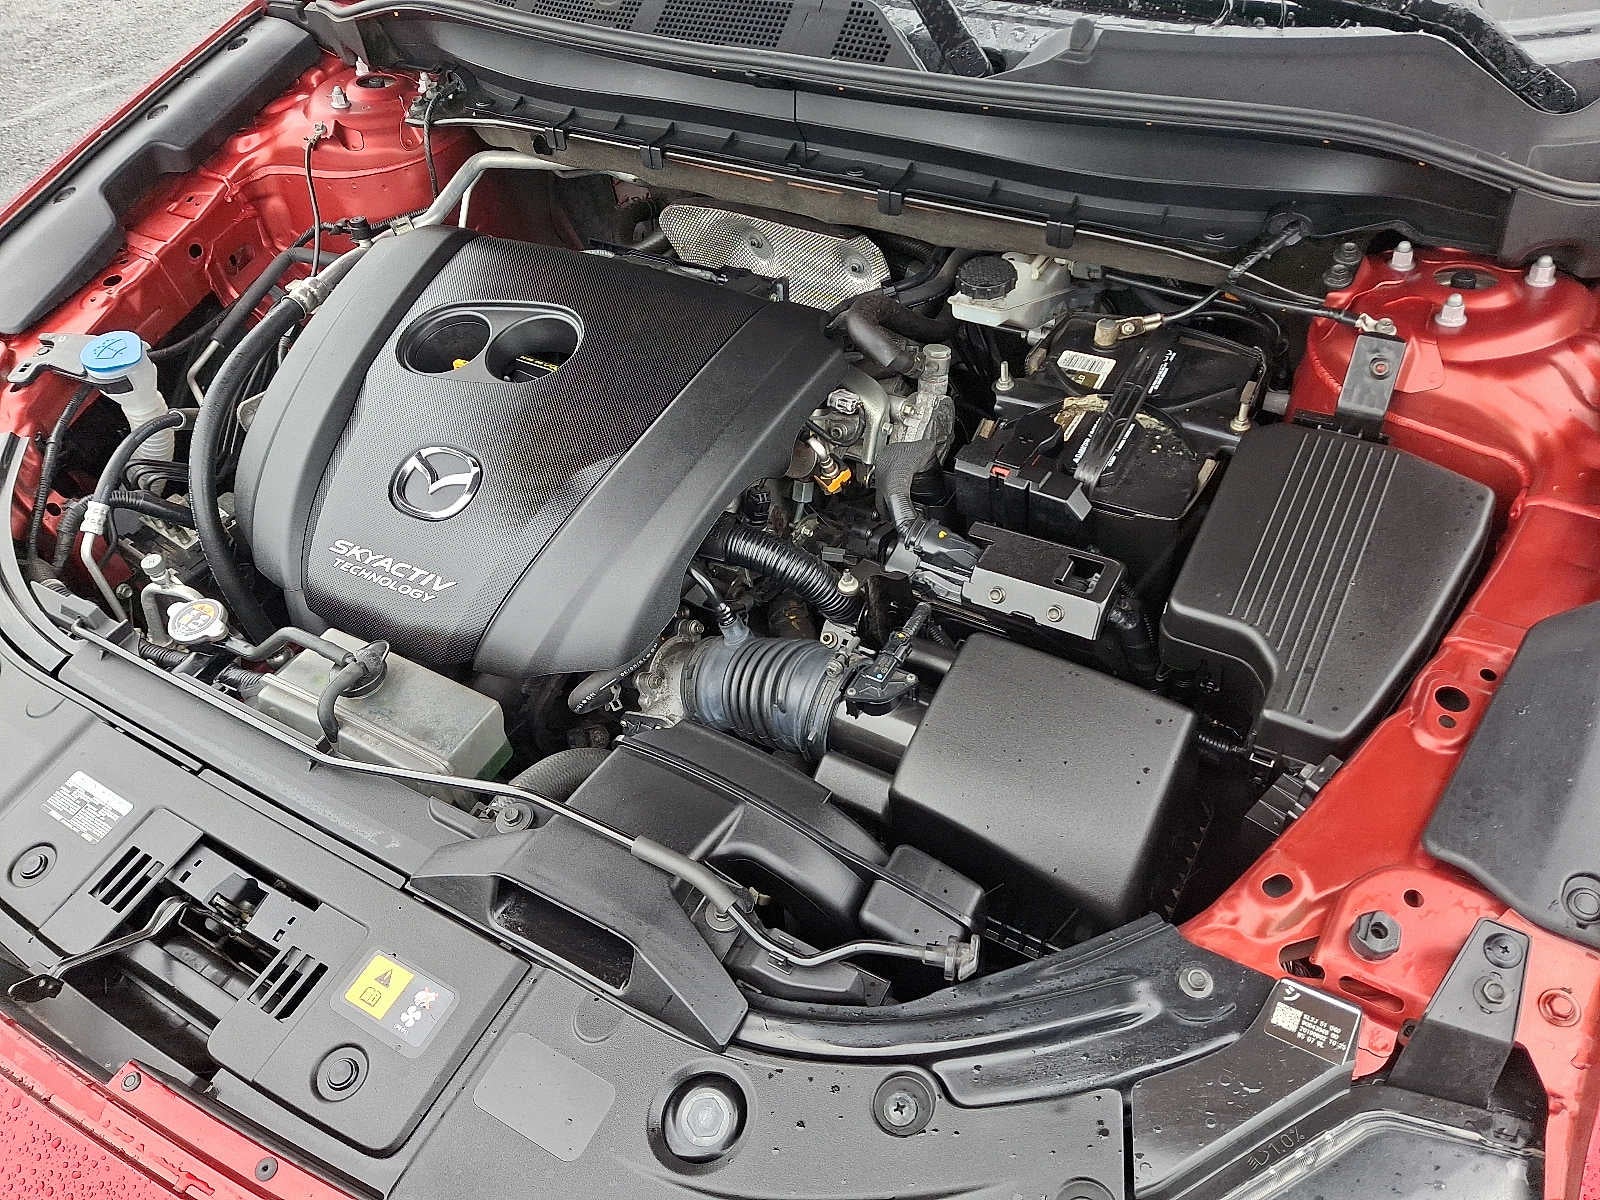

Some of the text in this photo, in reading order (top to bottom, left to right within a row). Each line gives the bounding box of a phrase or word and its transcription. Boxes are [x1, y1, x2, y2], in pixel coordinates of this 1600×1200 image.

[328, 539, 458, 592] SKYACTIV
[332, 557, 437, 603] TECHNOLOGY
[1267, 1126, 1306, 1154] 1.0%
